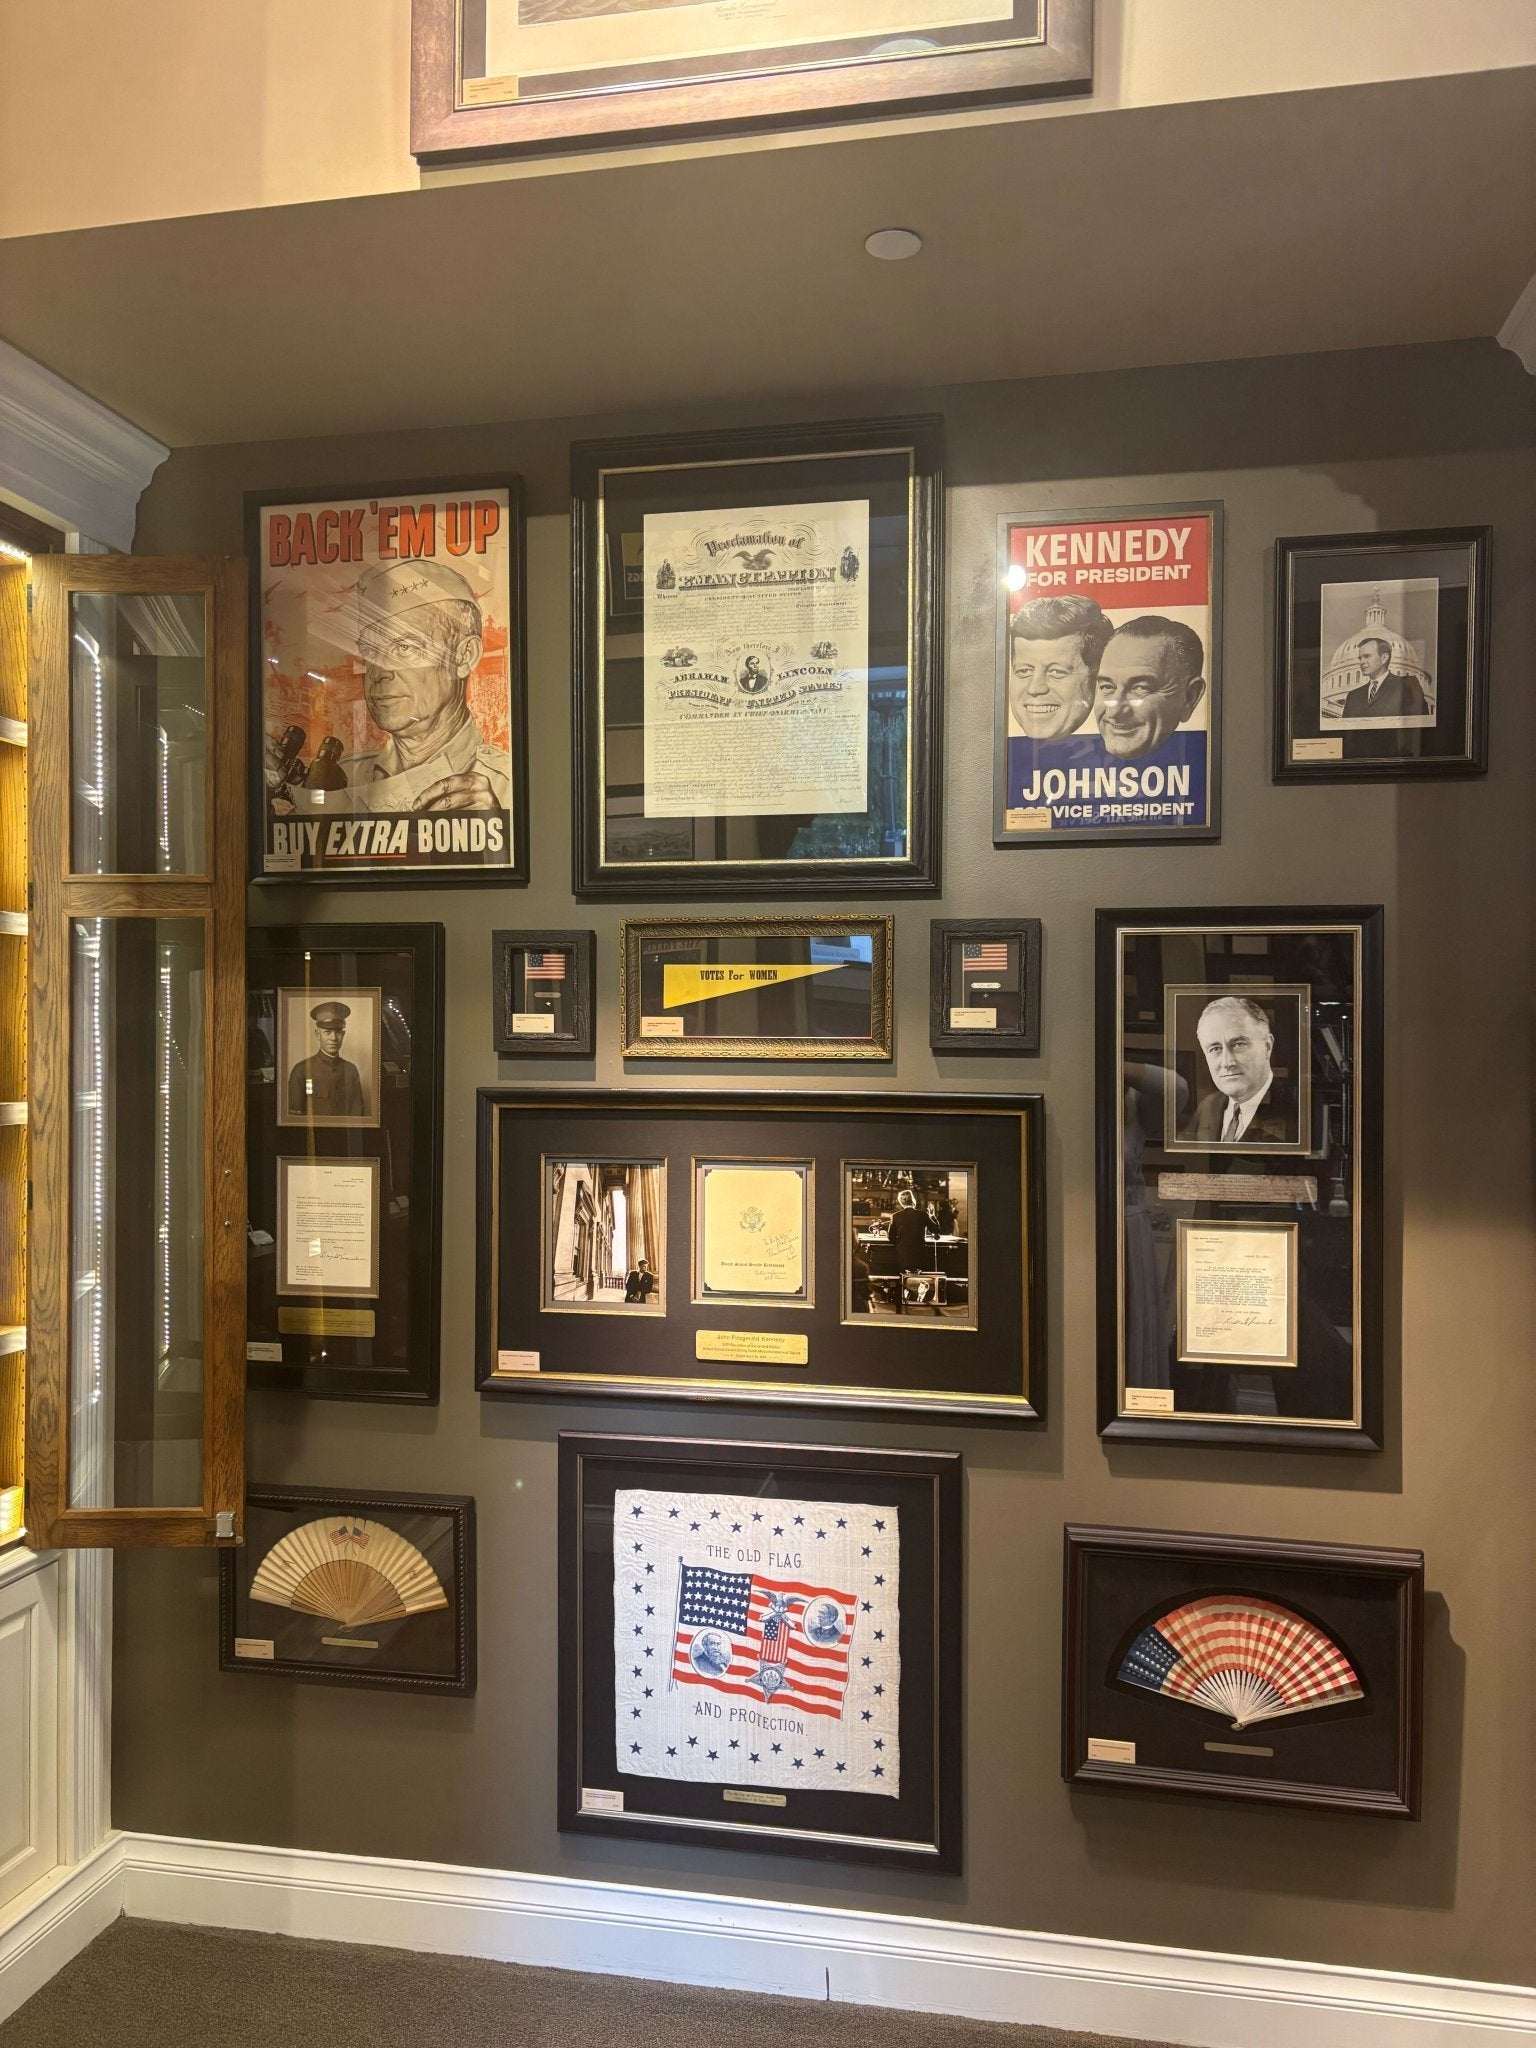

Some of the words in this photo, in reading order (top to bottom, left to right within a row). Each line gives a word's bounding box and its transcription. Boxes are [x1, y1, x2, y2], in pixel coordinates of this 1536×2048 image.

[269, 508, 366, 567] BACK
[369, 500, 436, 560] 'EM
[445, 499, 500, 556] UP
[703, 530, 787, 557] Proclamation
[788, 536, 806, 549] of
[1026, 527, 1192, 568] KENNEDY
[678, 567, 837, 591] EMANCIPATION
[1027, 570, 1067, 587] FOR
[1075, 564, 1192, 585] PRESIDENT
[743, 641, 772, 650] therefore
[672, 672, 730, 684] ABRAHAM
[776, 666, 834, 682] LINCOLN
[798, 682, 843, 695] STATES
[679, 711, 730, 720] COMMANDER
[1022, 765, 1190, 801] JOHNSON
[1053, 805, 1093, 818] VICE
[1099, 802, 1195, 817] PRESIDENT
[273, 821, 321, 856] BUY
[325, 819, 410, 855] EXTRA
[417, 817, 504, 853] BONDS
[700, 970, 725, 980] VOTES
[728, 970, 745, 980] For
[749, 969, 778, 980] WOMEN
[731, 1335, 760, 1343] Fitzgerald
[706, 1545, 731, 1560] THE
[737, 1548, 761, 1563] OLD
[768, 1552, 802, 1569] FLAG
[694, 1701, 722, 1719] AND
